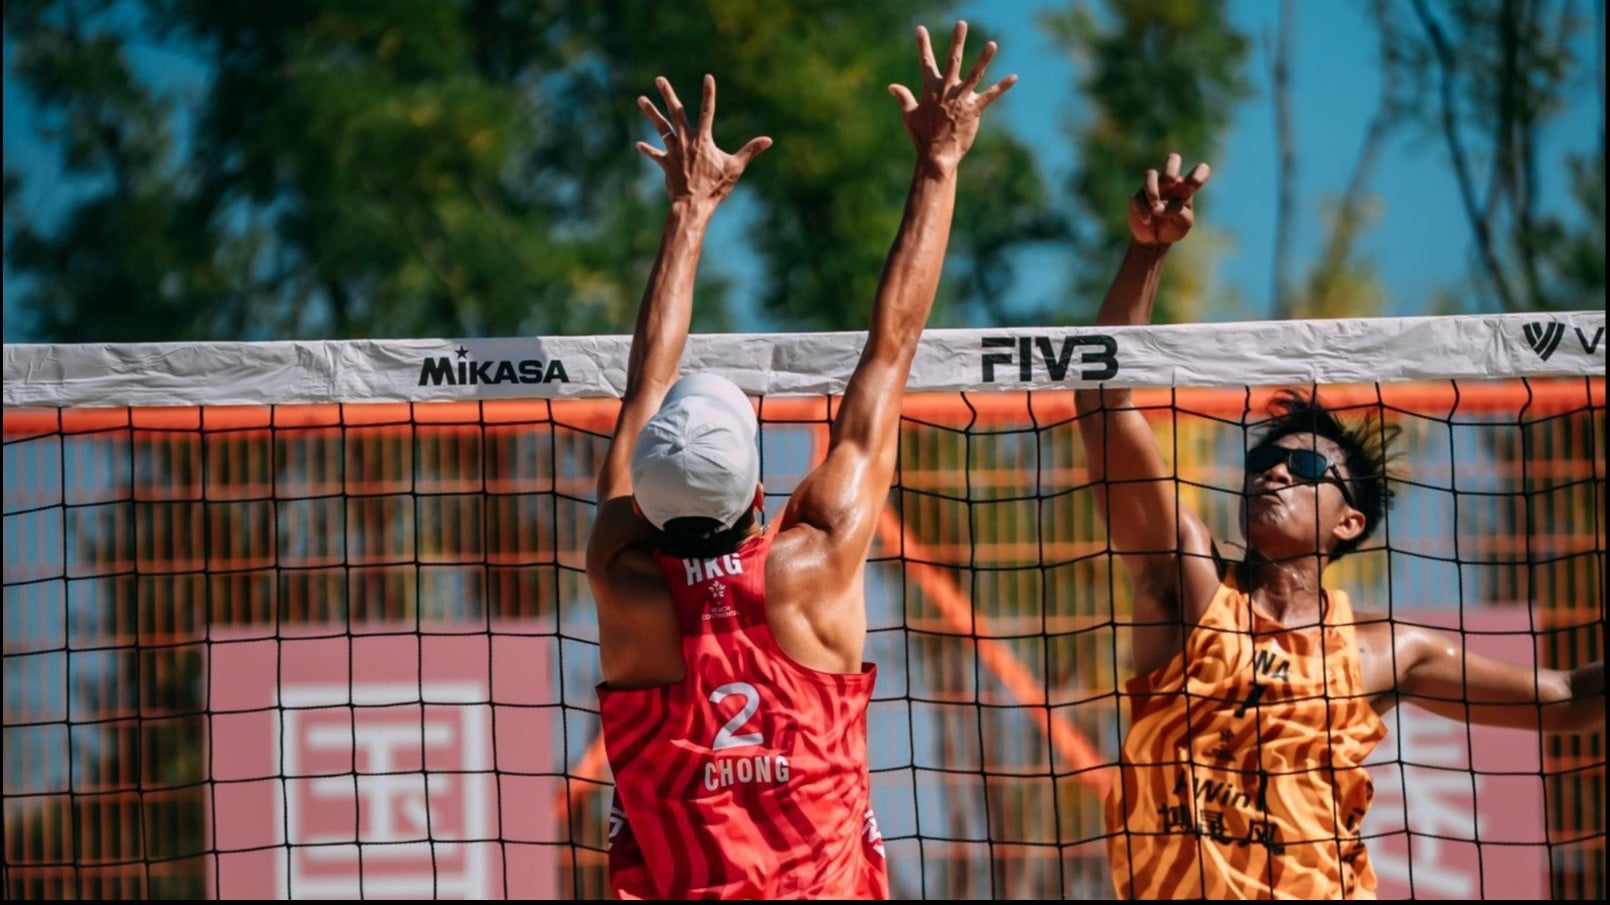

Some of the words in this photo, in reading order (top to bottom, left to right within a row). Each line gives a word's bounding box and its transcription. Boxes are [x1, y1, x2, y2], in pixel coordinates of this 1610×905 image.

[981, 334, 1119, 382] FIVB
[682, 552, 743, 586] HKG
[709, 682, 764, 751] 2
[704, 756, 790, 790] CHONG
